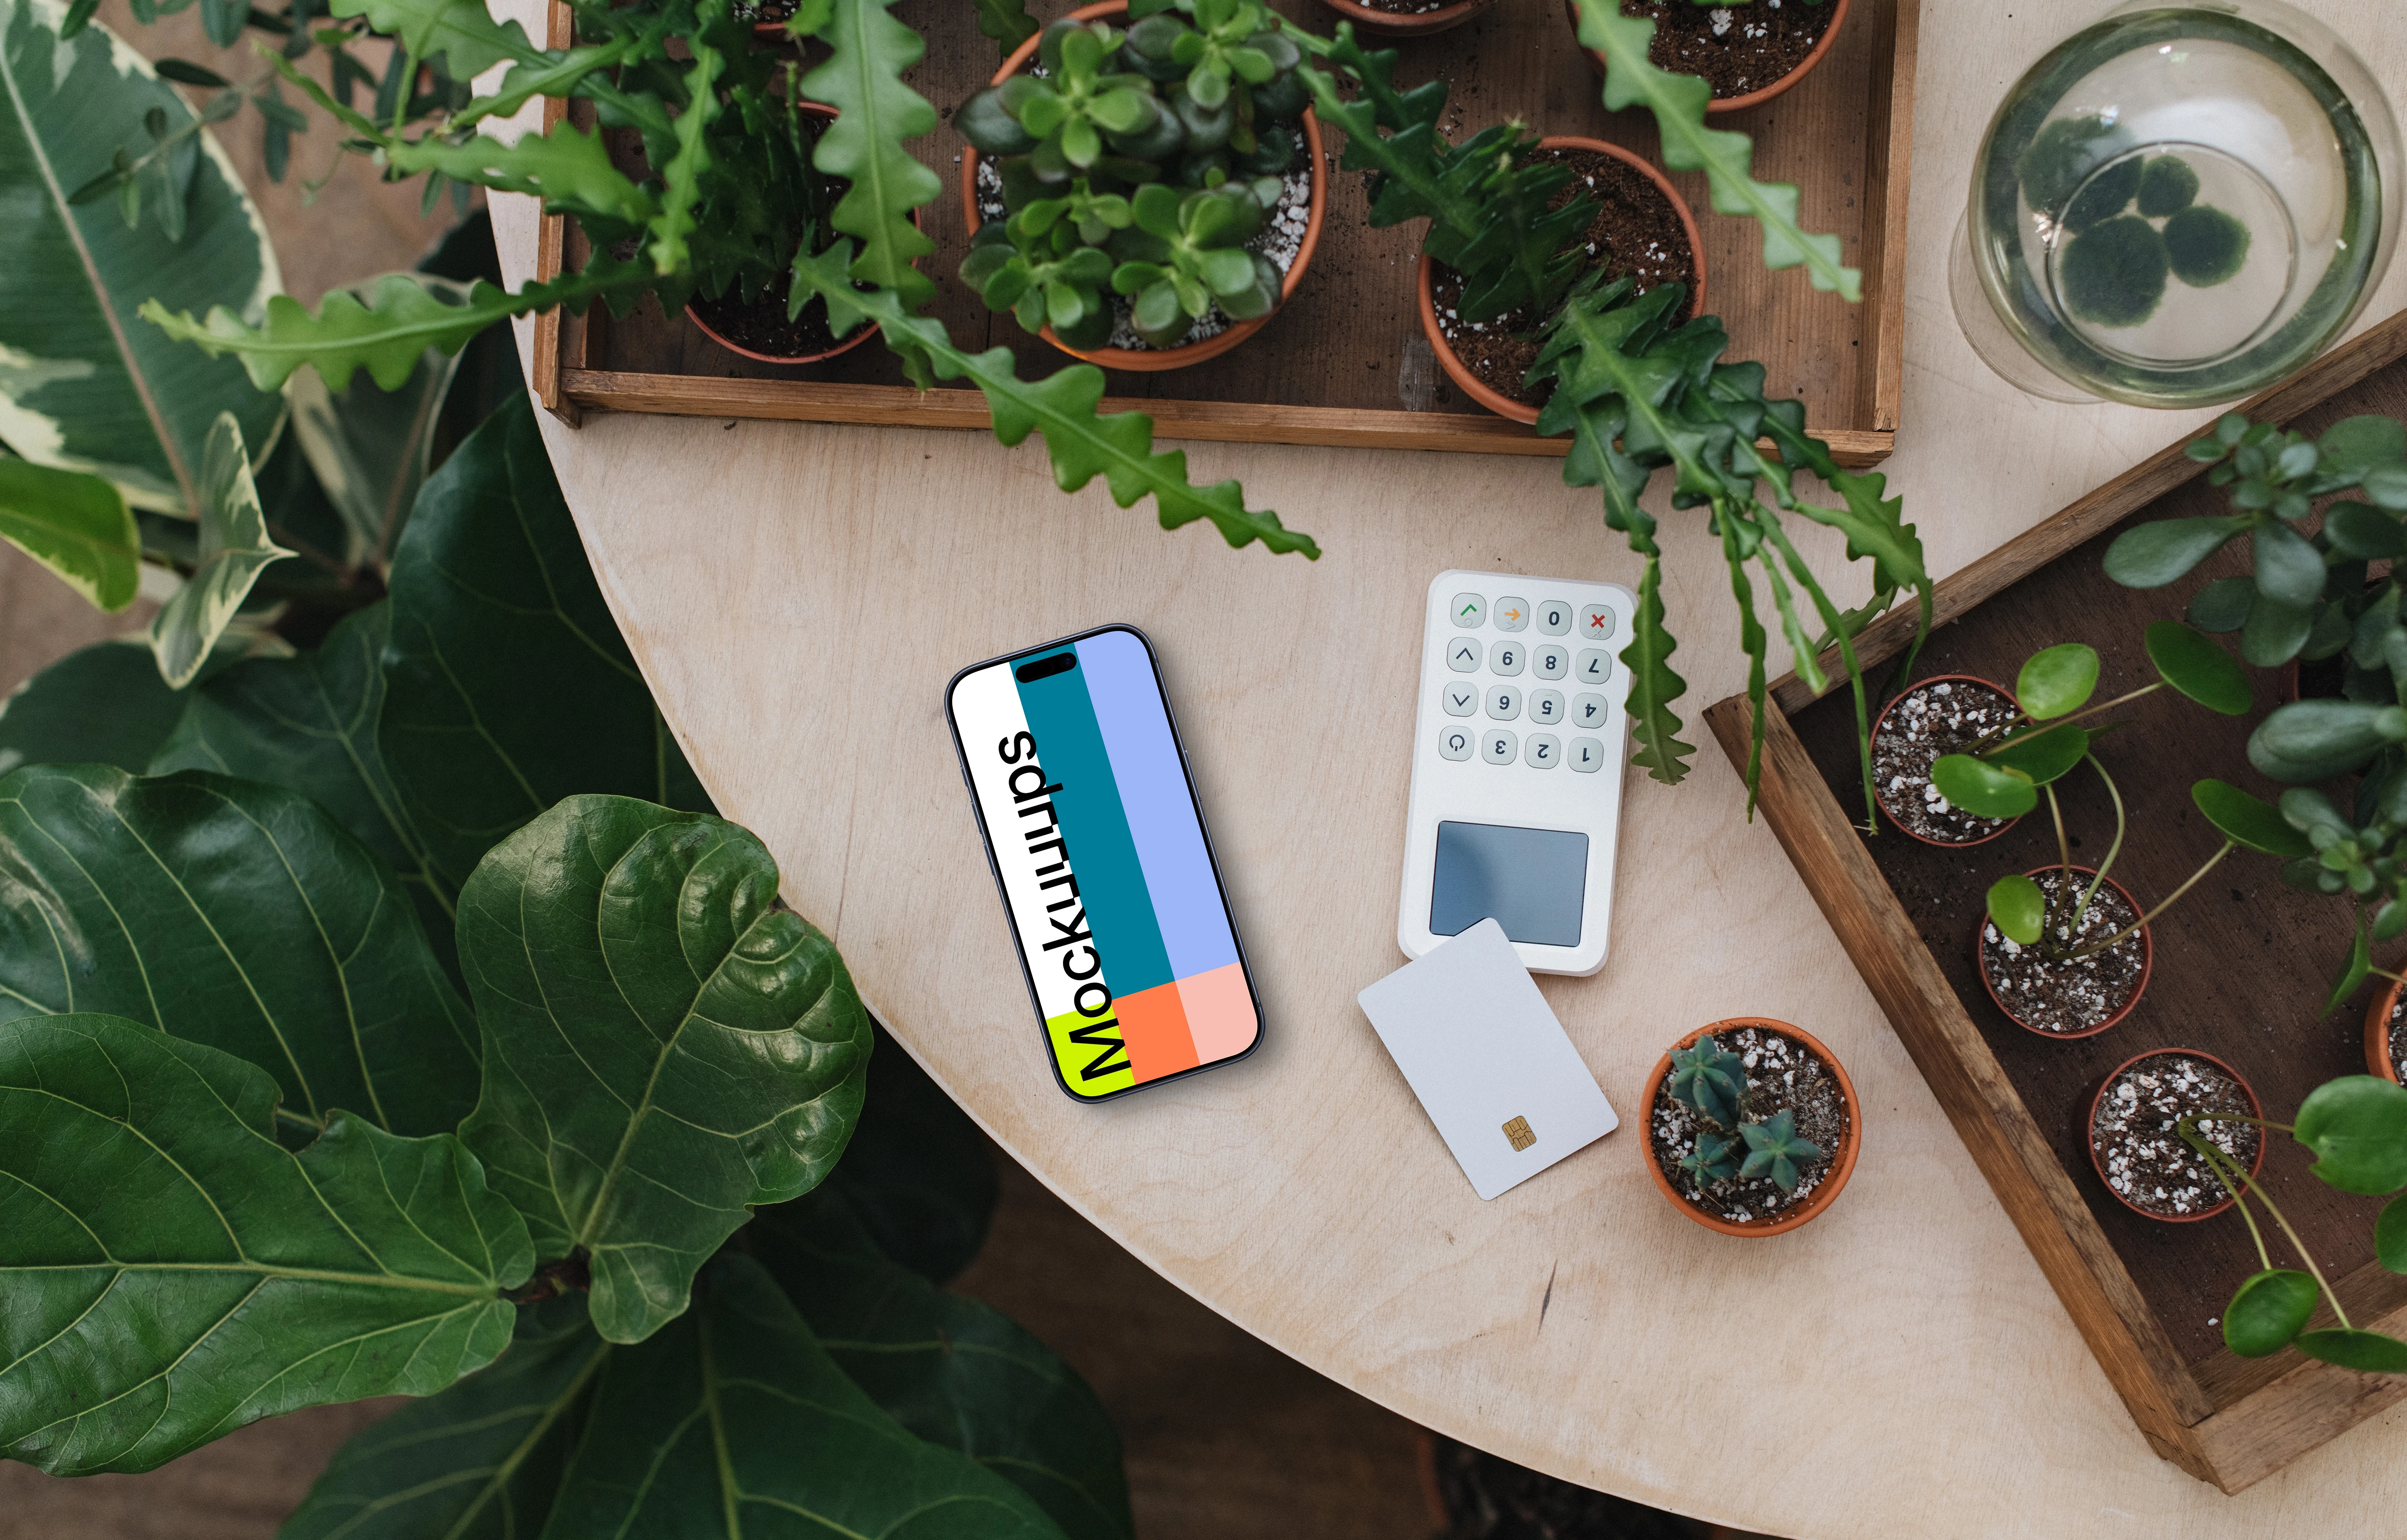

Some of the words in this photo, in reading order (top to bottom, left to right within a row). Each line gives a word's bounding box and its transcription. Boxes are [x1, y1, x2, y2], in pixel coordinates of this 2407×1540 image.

[1549, 611, 1560, 626] 0
[1502, 651, 1513, 666] 9
[1545, 655, 1556, 670] 8
[1588, 658, 1599, 673] 7
[1499, 695, 1510, 710] 6
[1541, 700, 1553, 715] 5
[1585, 703, 1597, 718] 4
[1495, 740, 1506, 755] 3
[1538, 744, 1549, 758] 2
[1582, 747, 1590, 762] 1
[998, 731, 1132, 1081] Mockuuups
